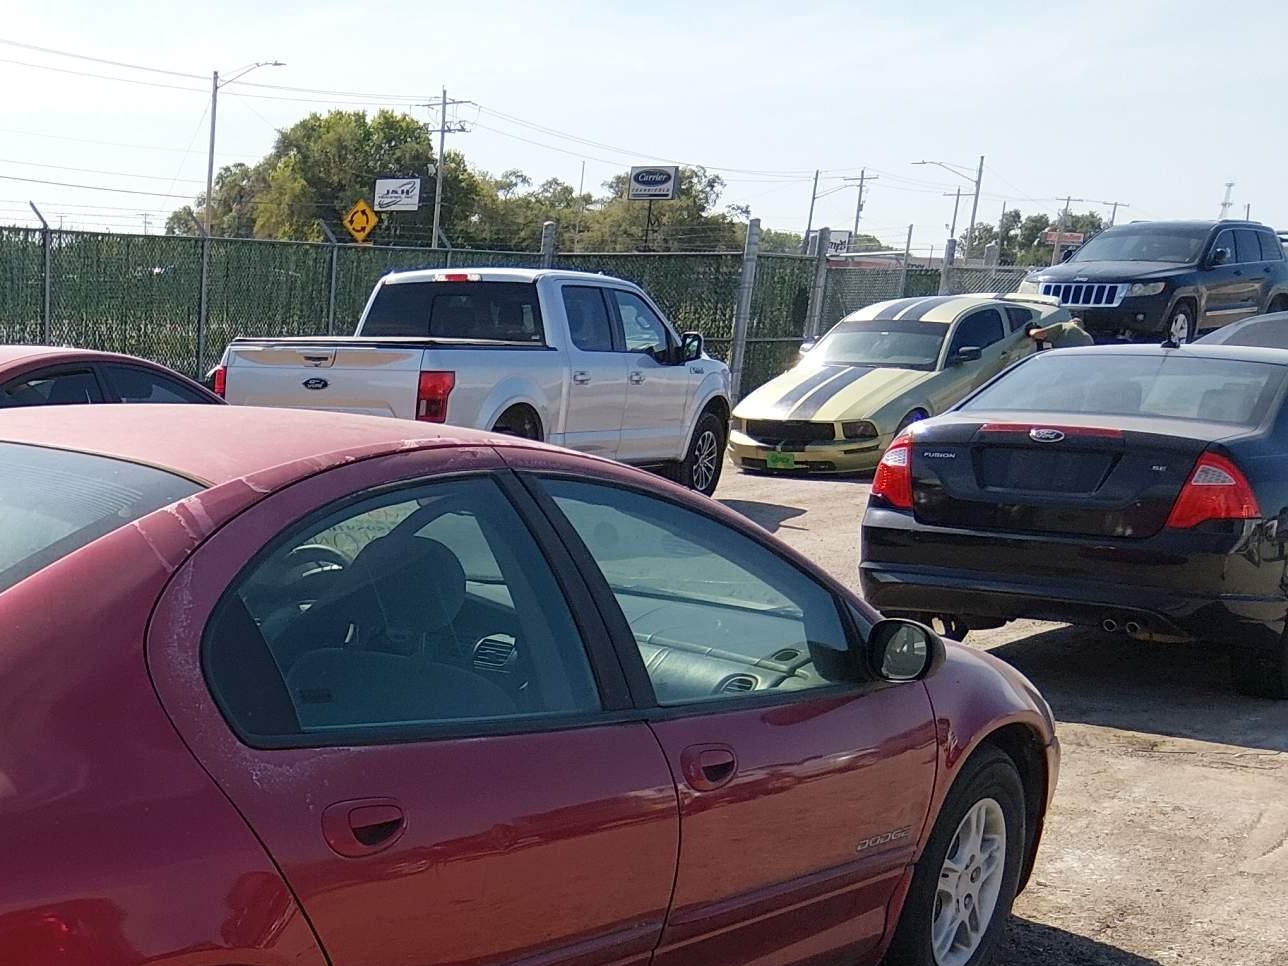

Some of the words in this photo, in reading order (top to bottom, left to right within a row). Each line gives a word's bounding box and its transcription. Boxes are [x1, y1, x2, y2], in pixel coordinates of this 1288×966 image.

[638, 172, 669, 182] Carrier
[923, 451, 956, 459] FUSION
[856, 824, 913, 851] DODGE
